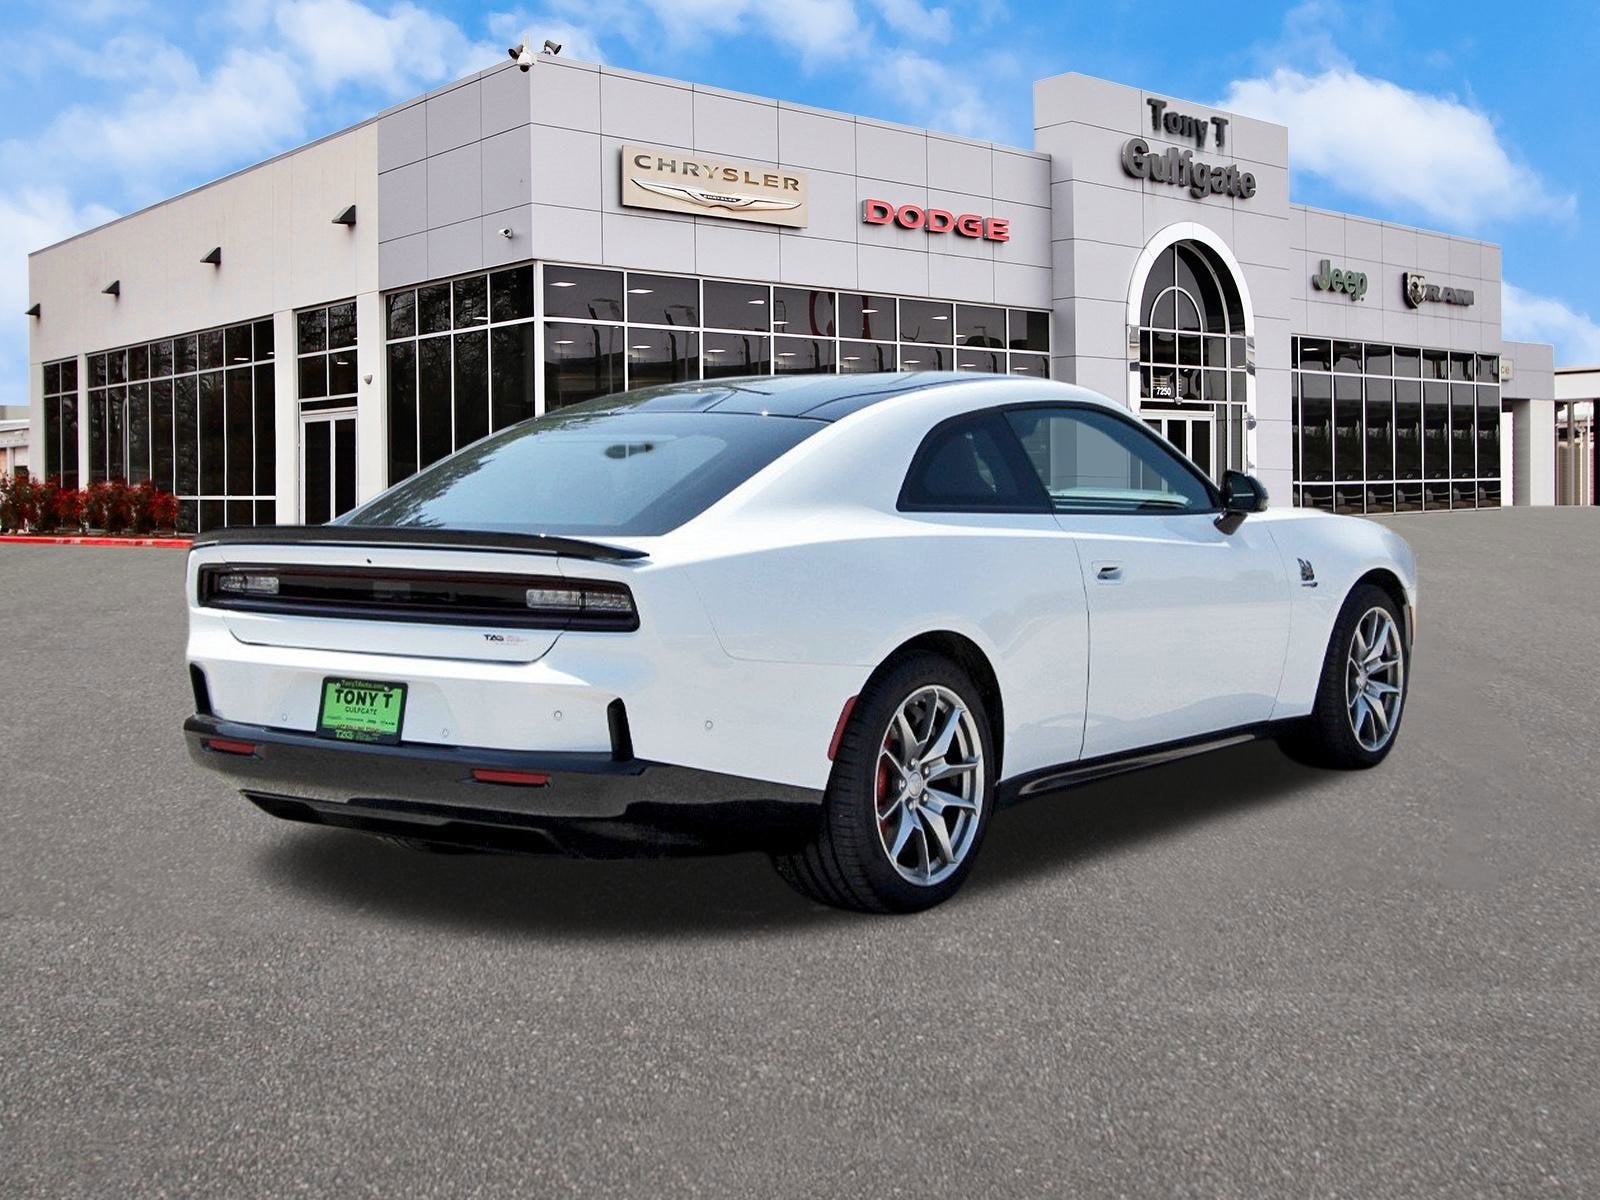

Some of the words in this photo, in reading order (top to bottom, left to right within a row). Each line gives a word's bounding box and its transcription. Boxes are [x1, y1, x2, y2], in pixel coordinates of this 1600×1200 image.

[1146, 98, 1208, 148] Tony
[1210, 116, 1229, 147] T
[633, 154, 800, 192] CHRYSLER
[1121, 138, 1256, 199] Gulfgate
[862, 198, 1010, 242] DODGE
[1312, 259, 1367, 302] Jeep
[1425, 284, 1475, 306] RAM
[335, 689, 378, 706] TONY
[383, 693, 393, 708] T
